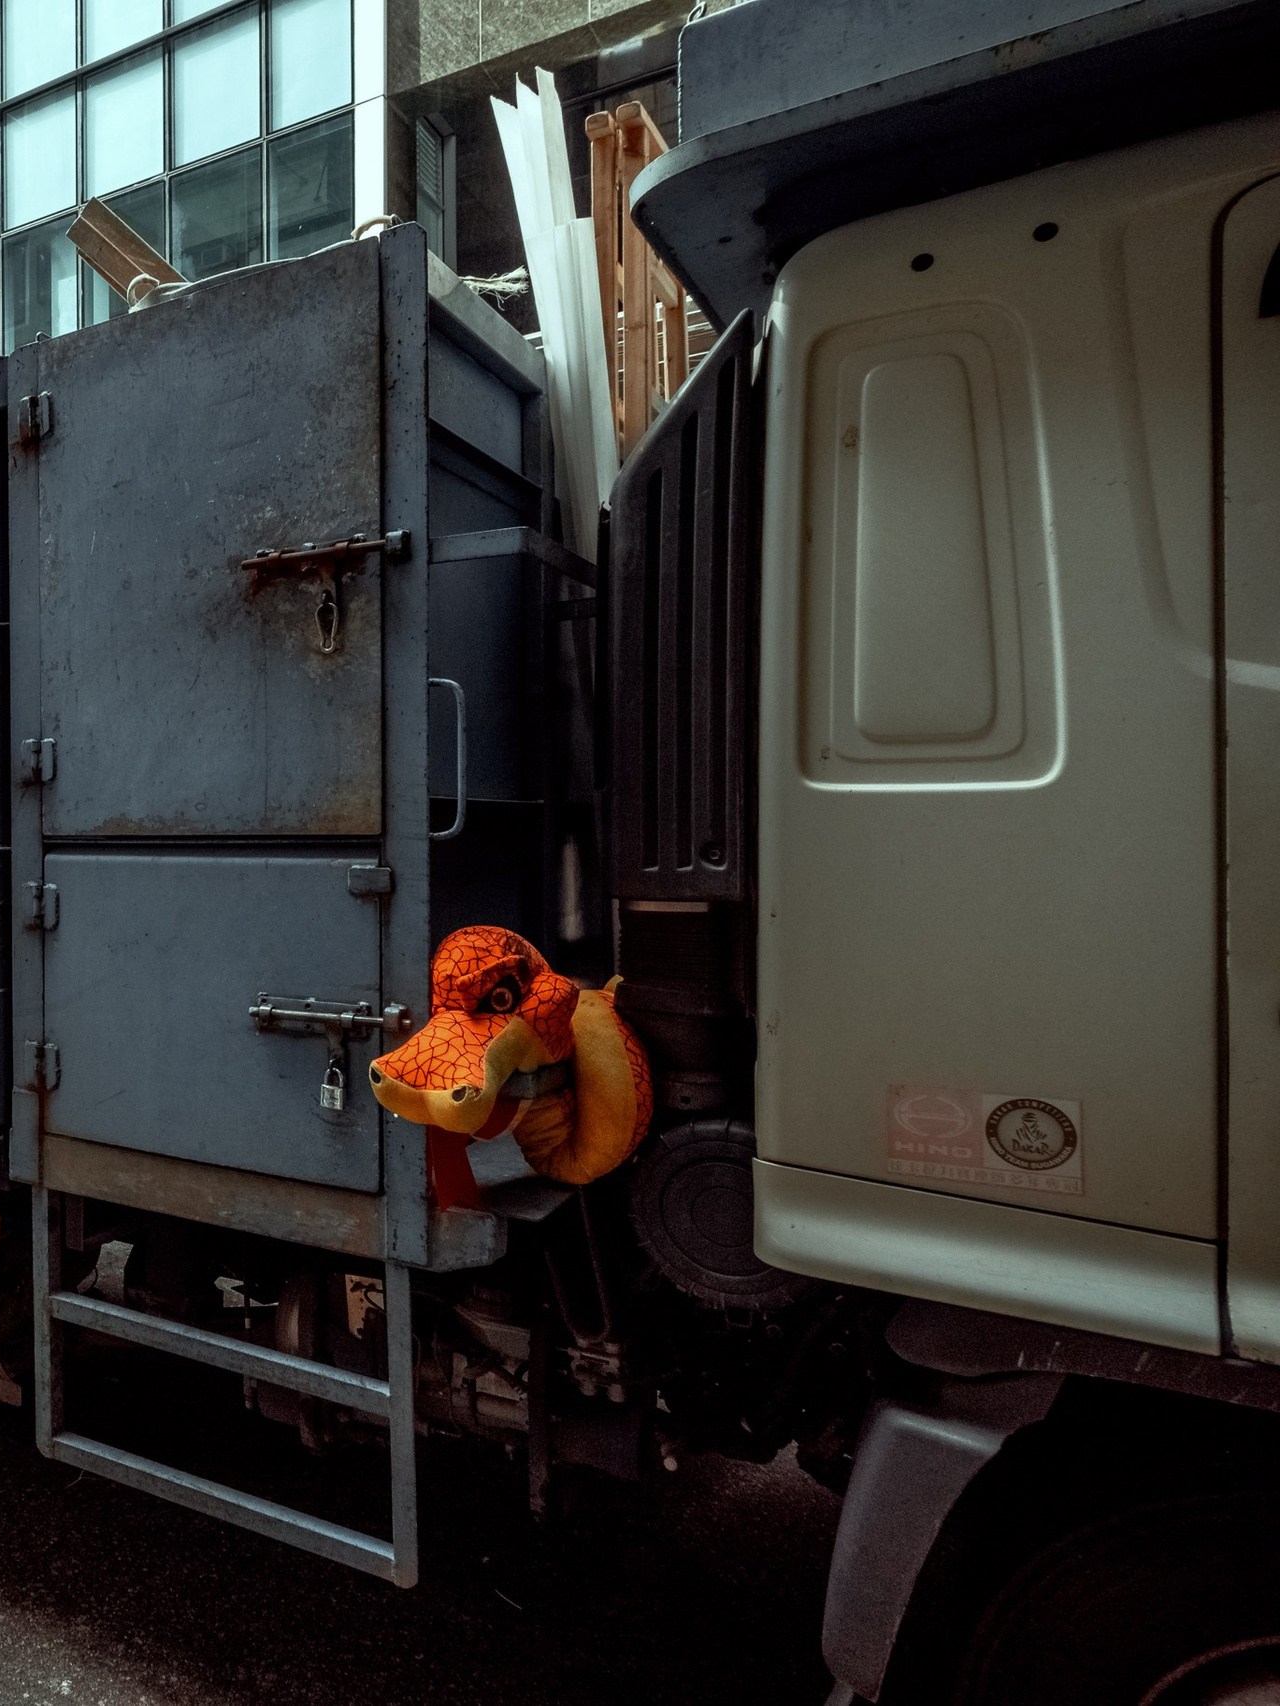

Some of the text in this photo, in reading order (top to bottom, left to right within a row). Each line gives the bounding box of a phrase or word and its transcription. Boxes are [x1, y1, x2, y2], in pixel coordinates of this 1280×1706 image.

[894, 1140, 974, 1158] HINO
[989, 1136, 1074, 1169] HINO TEAM SUGAWARA
